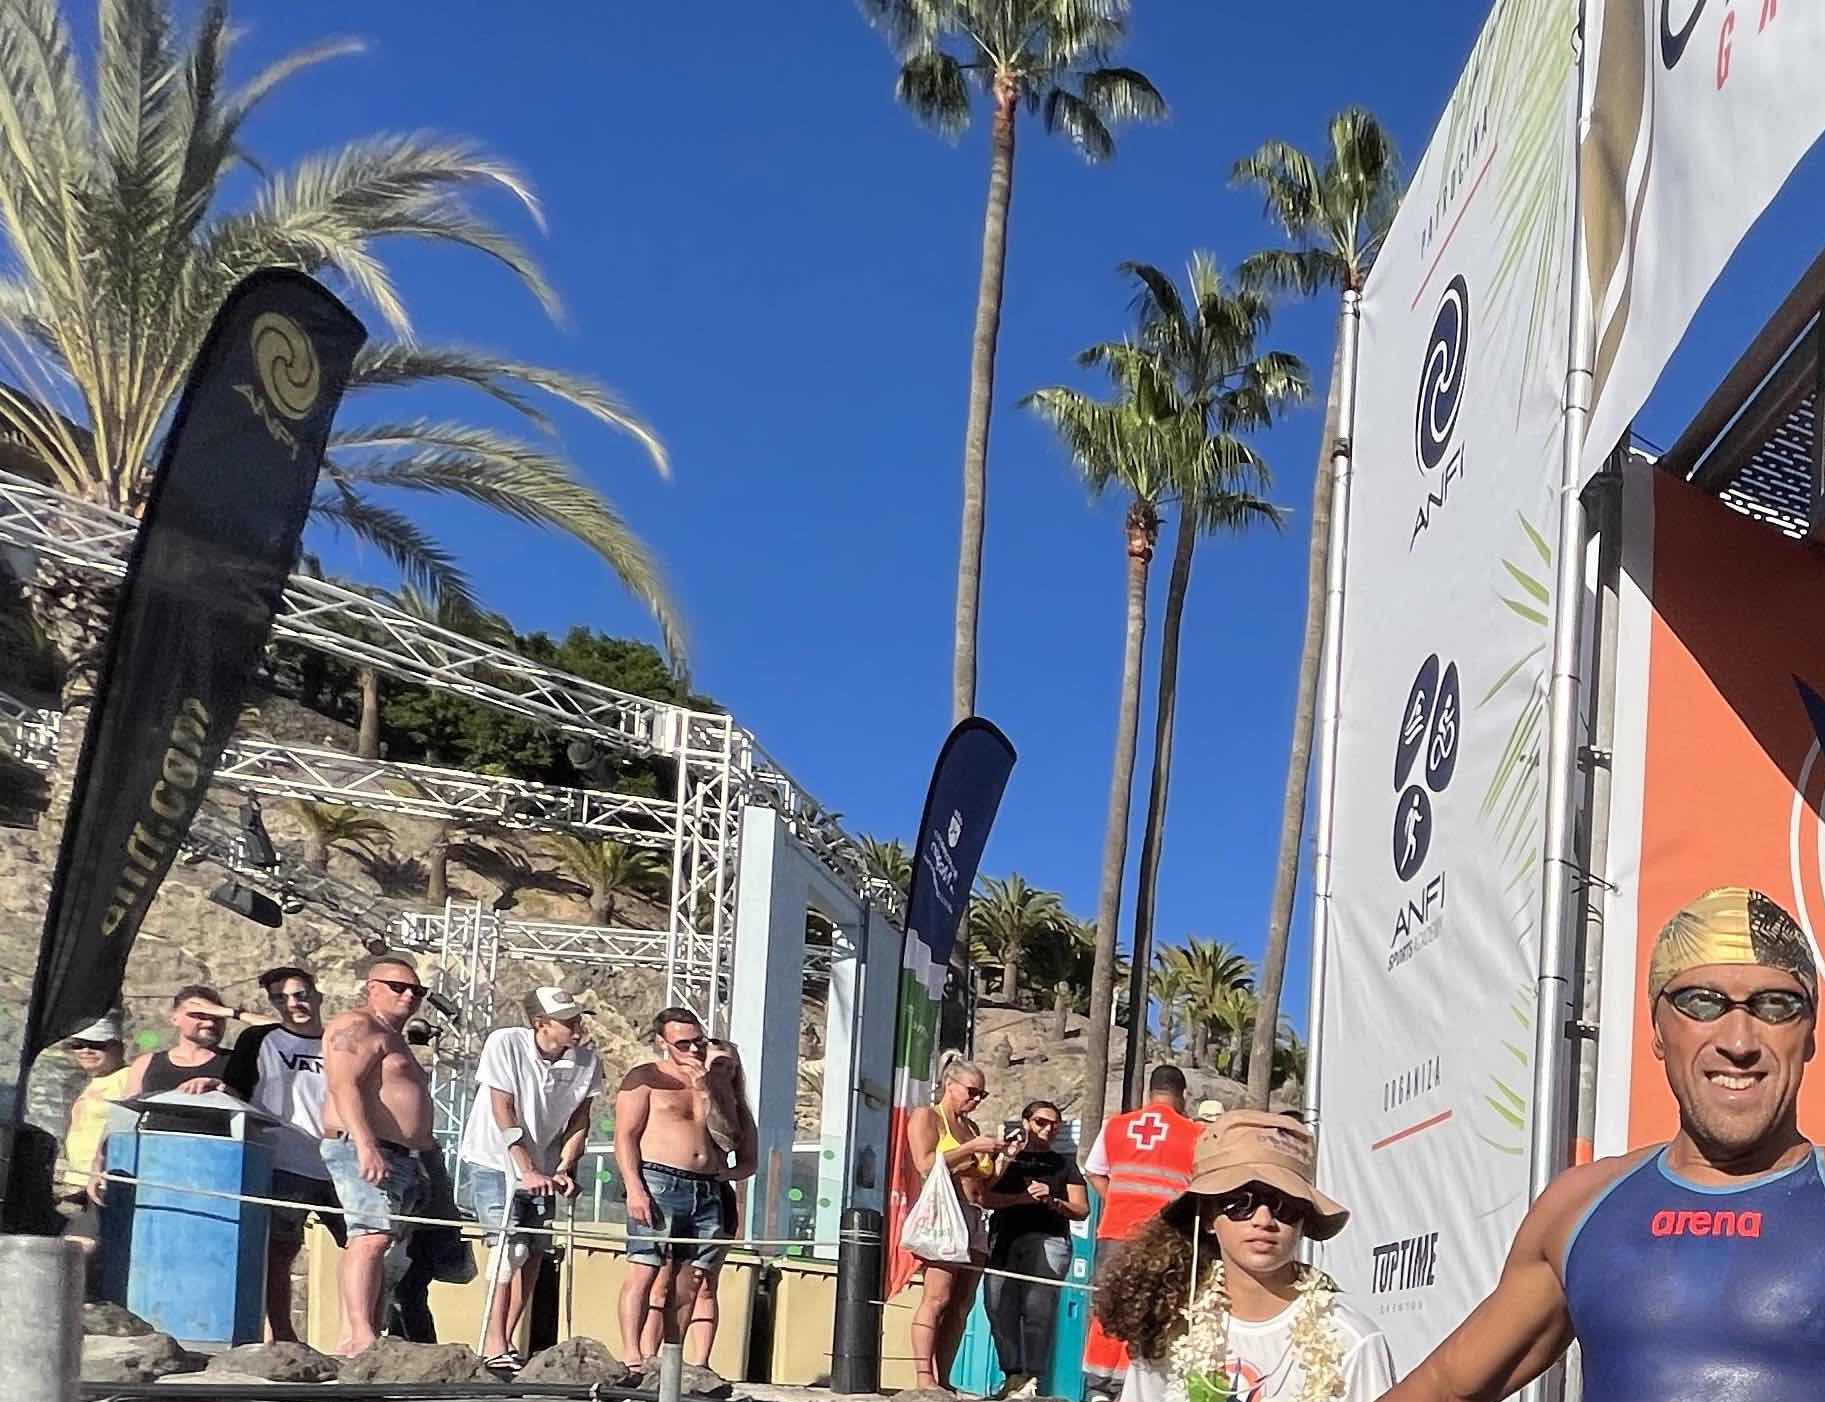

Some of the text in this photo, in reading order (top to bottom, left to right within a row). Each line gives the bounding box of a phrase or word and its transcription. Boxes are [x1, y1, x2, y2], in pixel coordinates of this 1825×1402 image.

[1409, 440, 1465, 552] ANFI
[1391, 871, 1446, 949] ANFI
[278, 1050, 324, 1075] VAN
[1651, 1210, 1763, 1238] arena
[1372, 1231, 1440, 1294] TOPTIME
